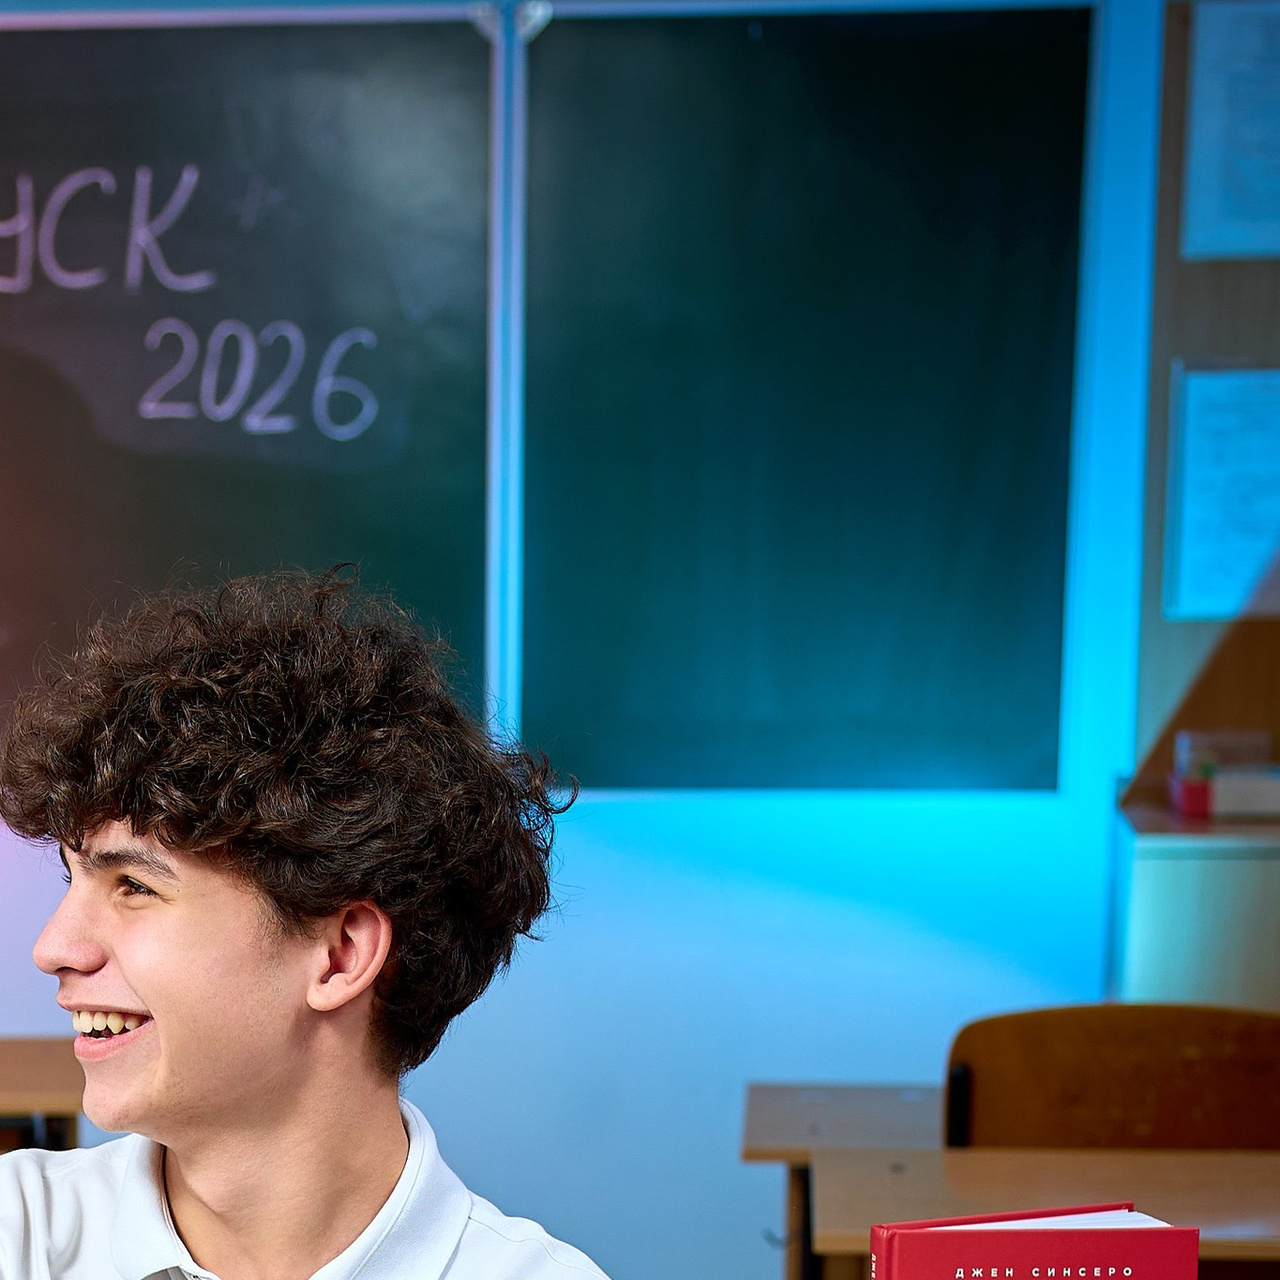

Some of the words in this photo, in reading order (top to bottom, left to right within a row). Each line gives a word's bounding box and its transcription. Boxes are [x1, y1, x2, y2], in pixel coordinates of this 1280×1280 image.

[138, 316, 379, 442] 2026
[955, 1268, 1014, 1279] ДЖЕН
[1032, 1267, 1133, 1277] СИНСЕРО
